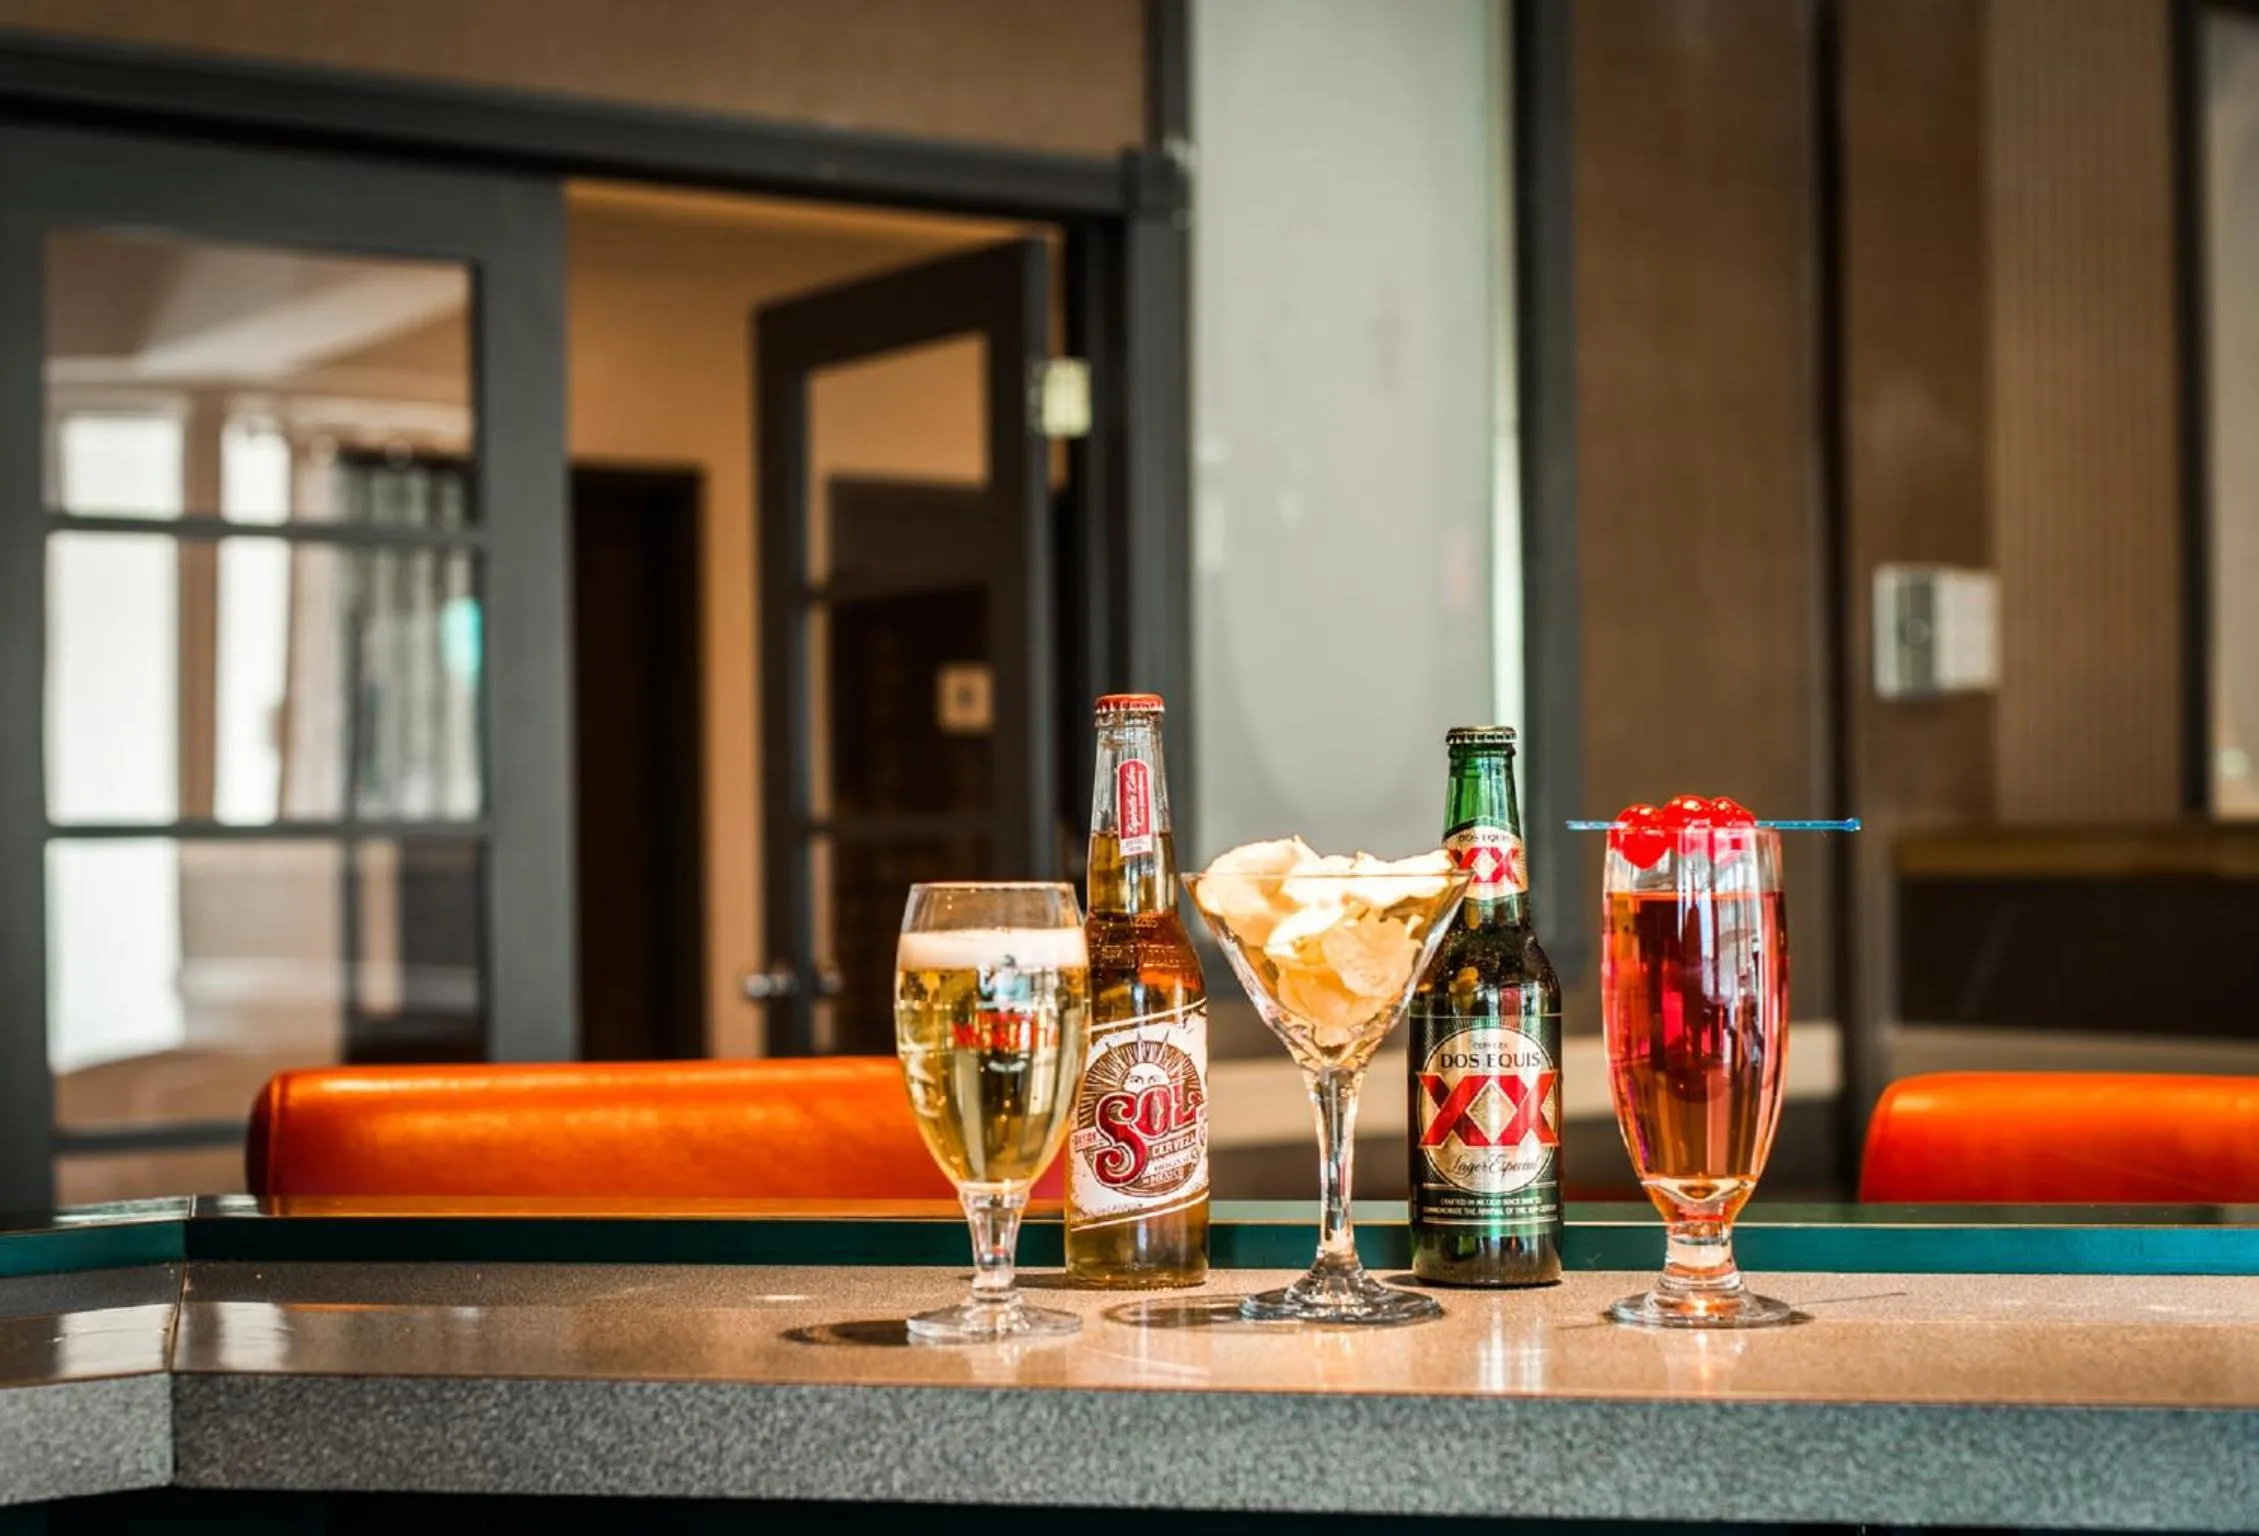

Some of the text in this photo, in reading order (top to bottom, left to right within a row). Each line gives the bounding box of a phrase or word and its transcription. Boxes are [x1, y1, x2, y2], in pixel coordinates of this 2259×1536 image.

[1448, 846, 1521, 886] XX
[1440, 1051, 1541, 1069] DOS EQUIS
[1417, 1071, 1560, 1149] XX
[1094, 1083, 1203, 1188] SOL
[1449, 1152, 1541, 1178] Lager Especial
